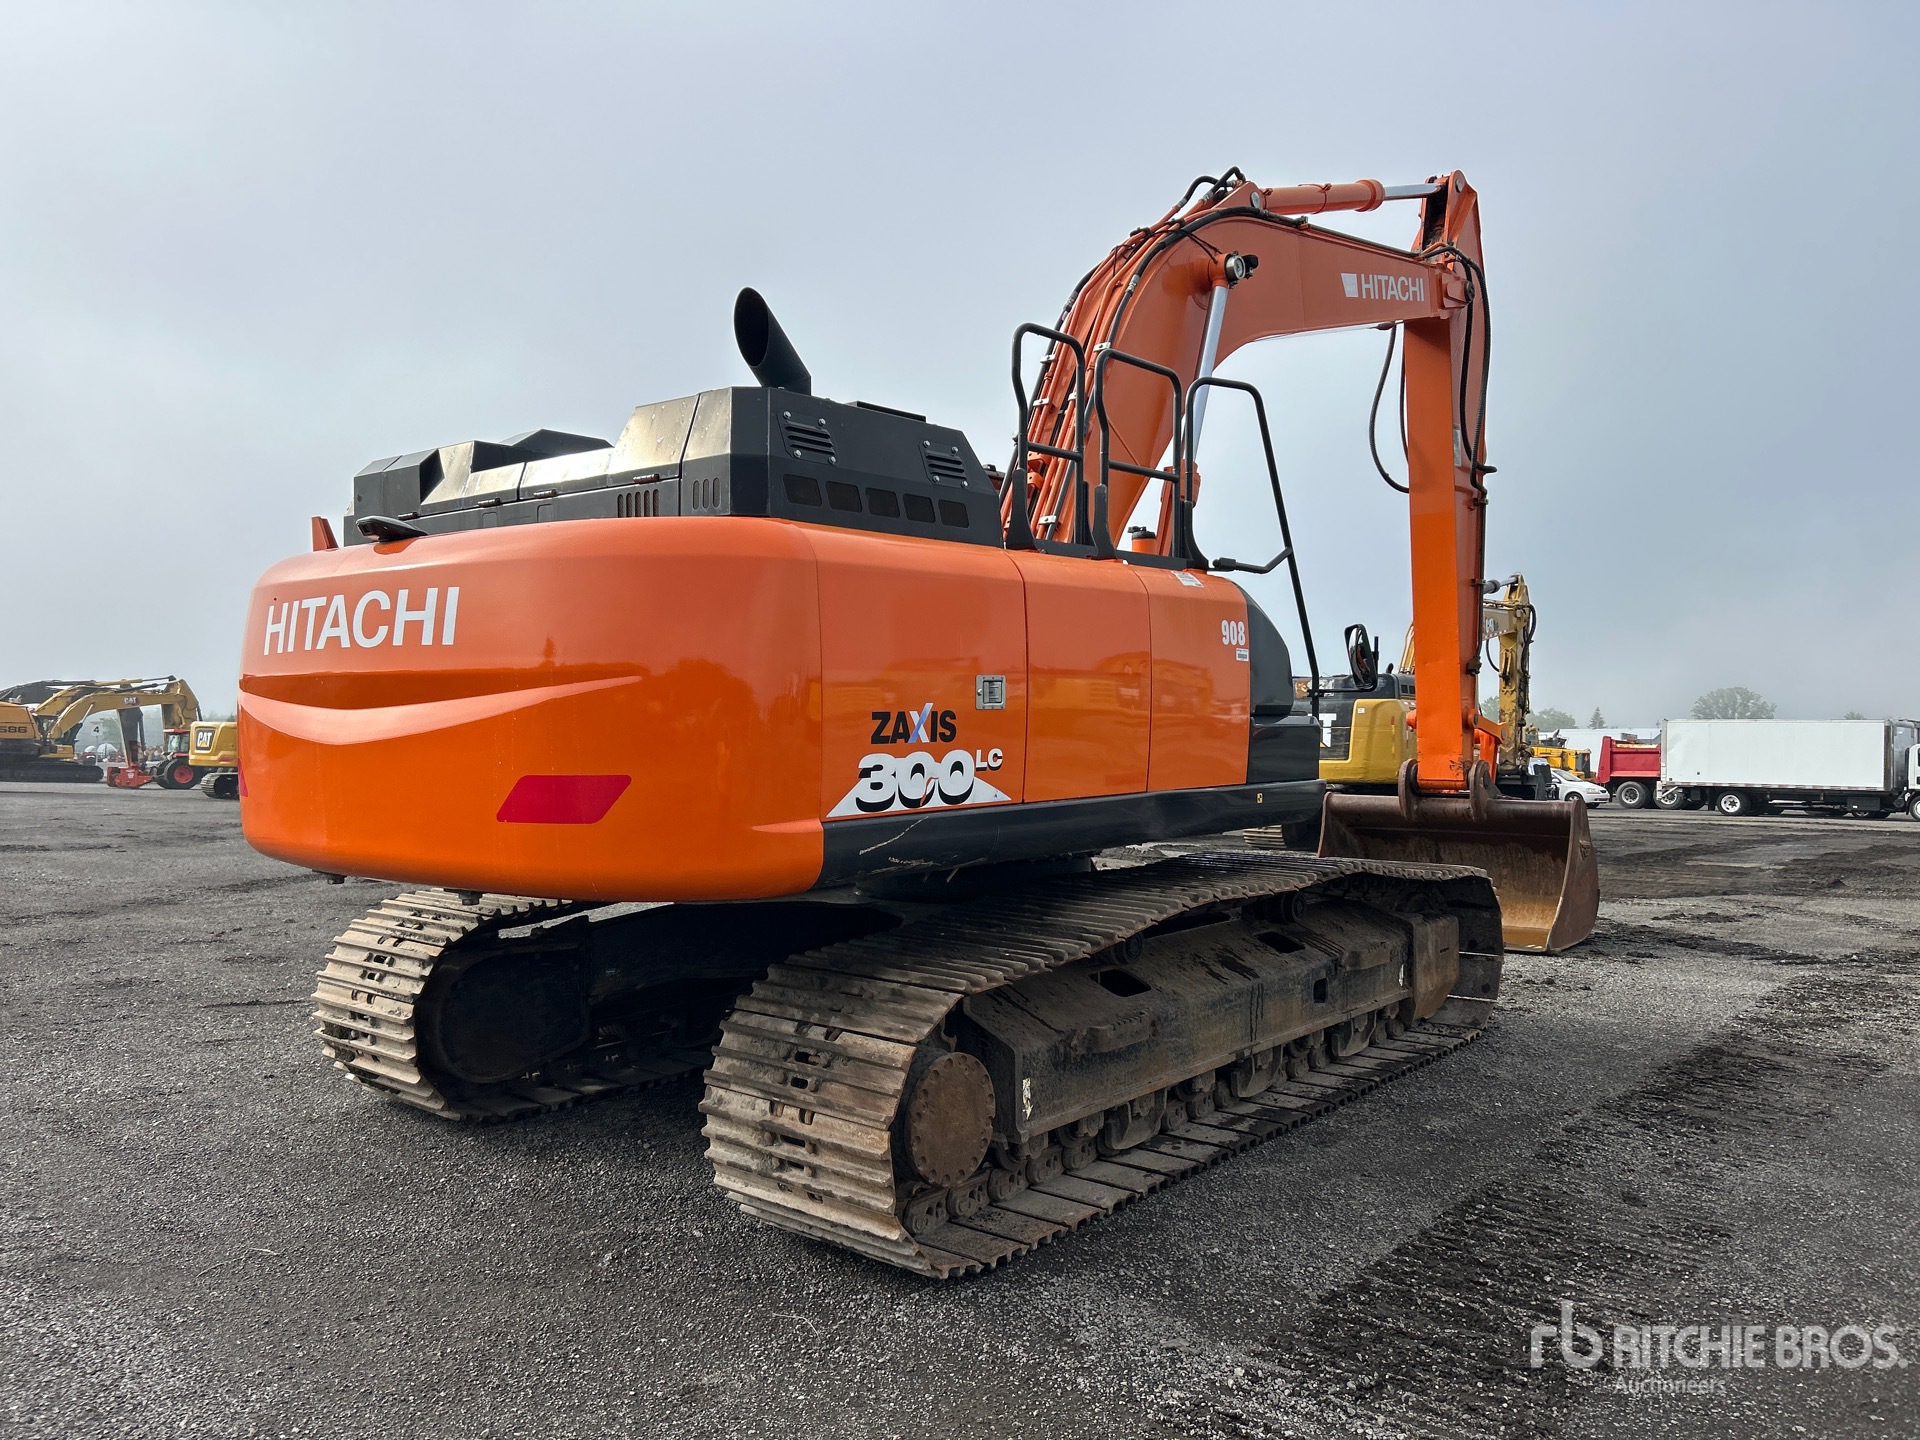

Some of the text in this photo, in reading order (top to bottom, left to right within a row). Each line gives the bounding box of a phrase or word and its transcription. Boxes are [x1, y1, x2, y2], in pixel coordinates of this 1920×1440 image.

[1361, 273, 1425, 302] HITACHI
[263, 586, 460, 656] HITACHI
[1221, 619, 1246, 646] 908
[124, 697, 137, 705] CAT
[870, 702, 957, 745] ZAXIS
[197, 732, 212, 748] CAT
[855, 748, 1003, 812] 300 LC
